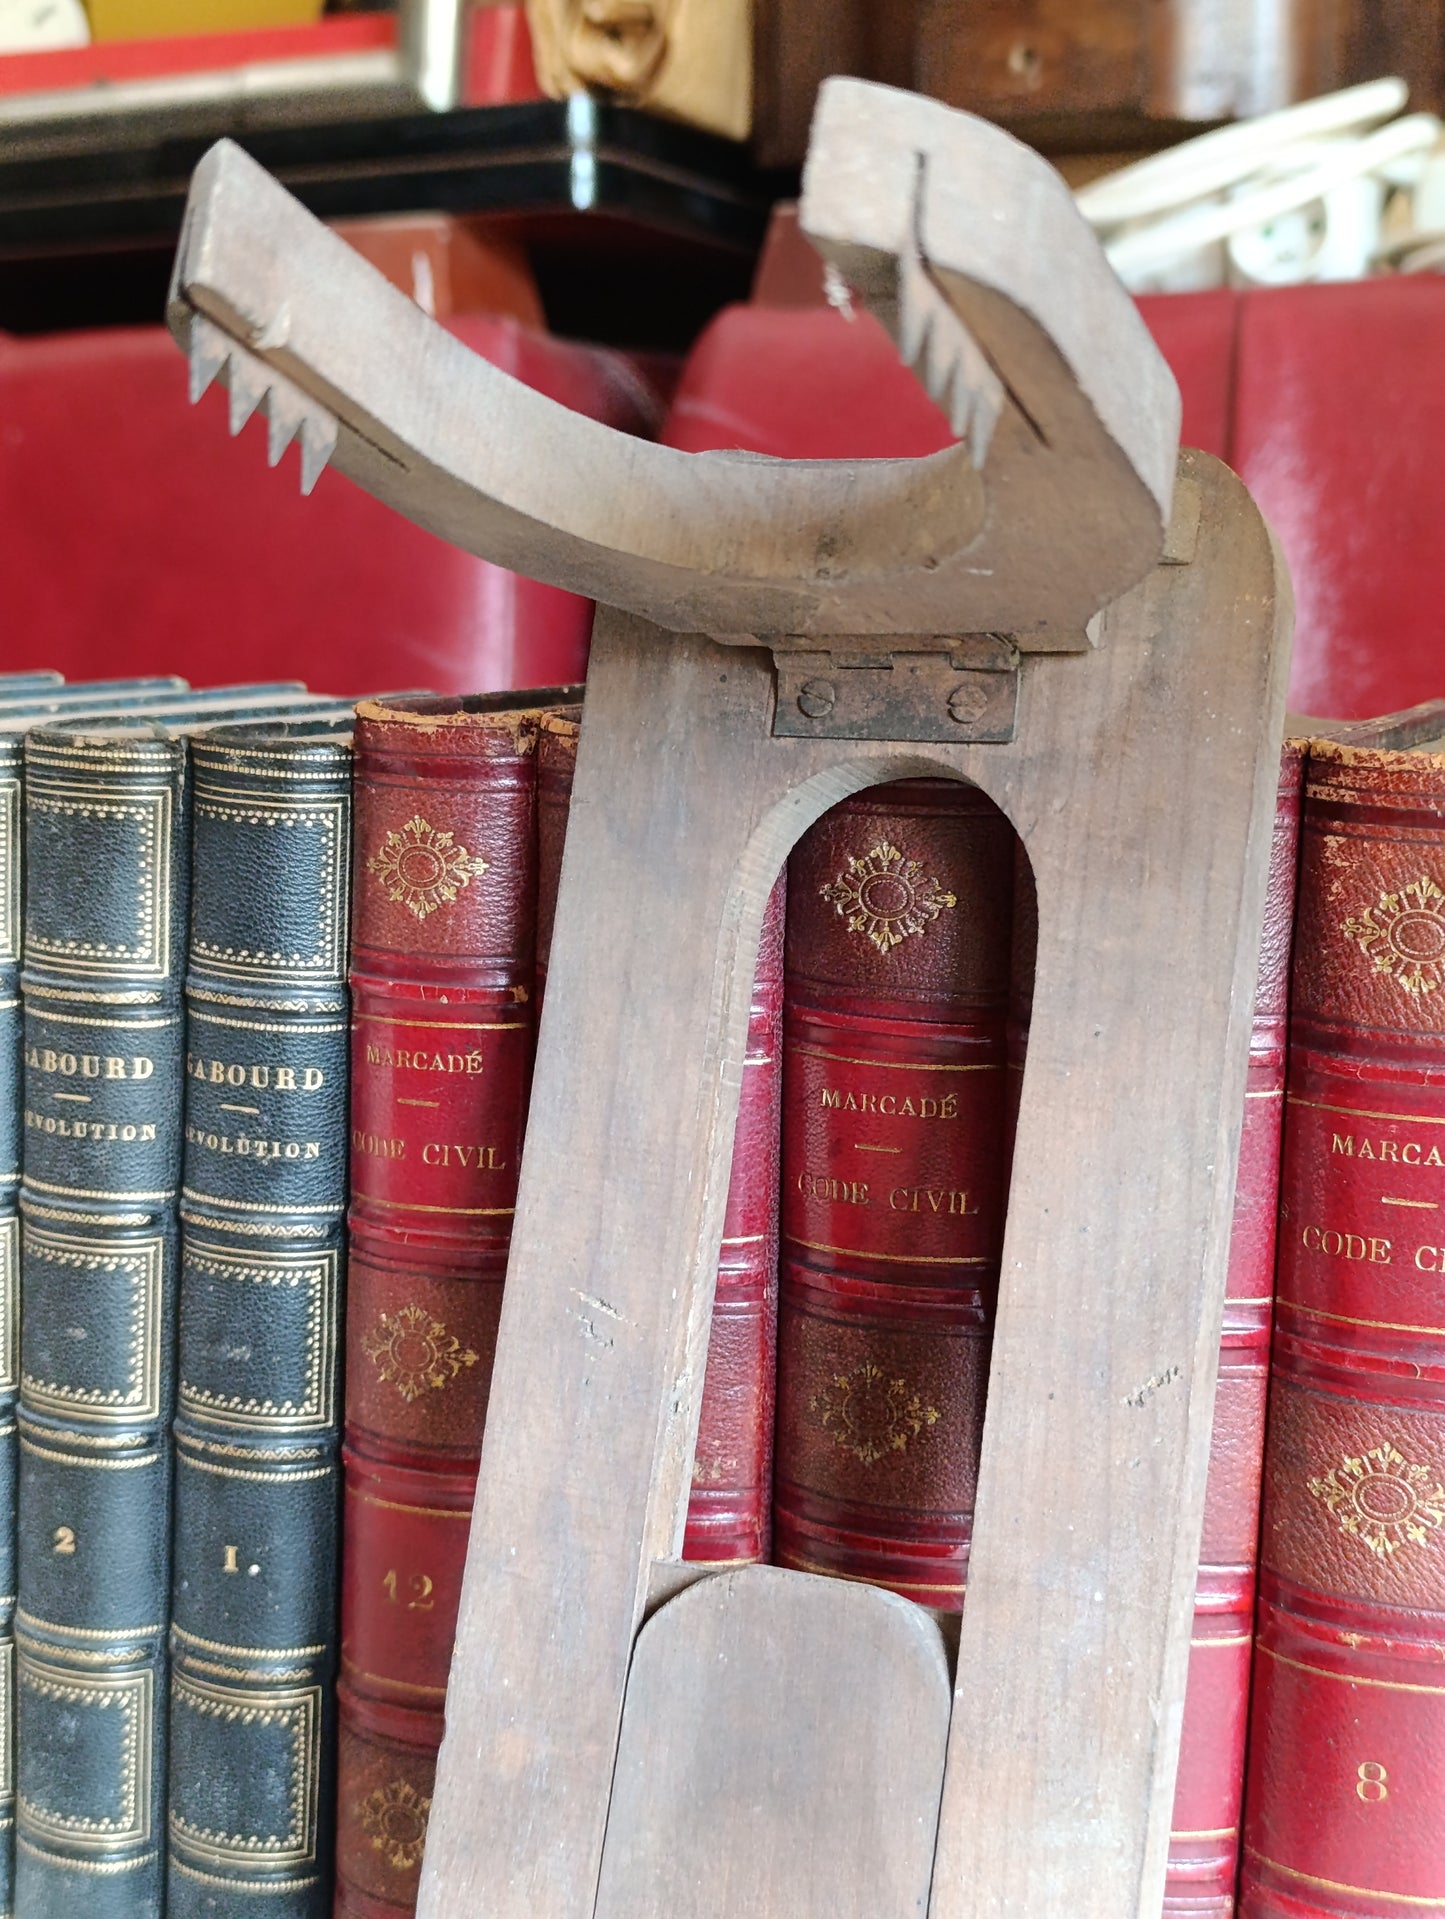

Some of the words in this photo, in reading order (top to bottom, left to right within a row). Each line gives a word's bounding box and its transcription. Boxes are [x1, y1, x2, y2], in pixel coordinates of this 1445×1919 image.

[366, 1045, 484, 1074] MARCADÉ
[820, 1088, 959, 1119] MARCADÉ
[353, 1130, 406, 1161] CODE
[422, 1143, 506, 1171] CIVIL
[798, 1170, 871, 1206] CODE
[889, 1186, 980, 1216] CIVIL
[1302, 1225, 1393, 1265] CODE
[54, 1526, 77, 1554] 2
[382, 1569, 435, 1611] 12
[1355, 1761, 1389, 1802] 8
